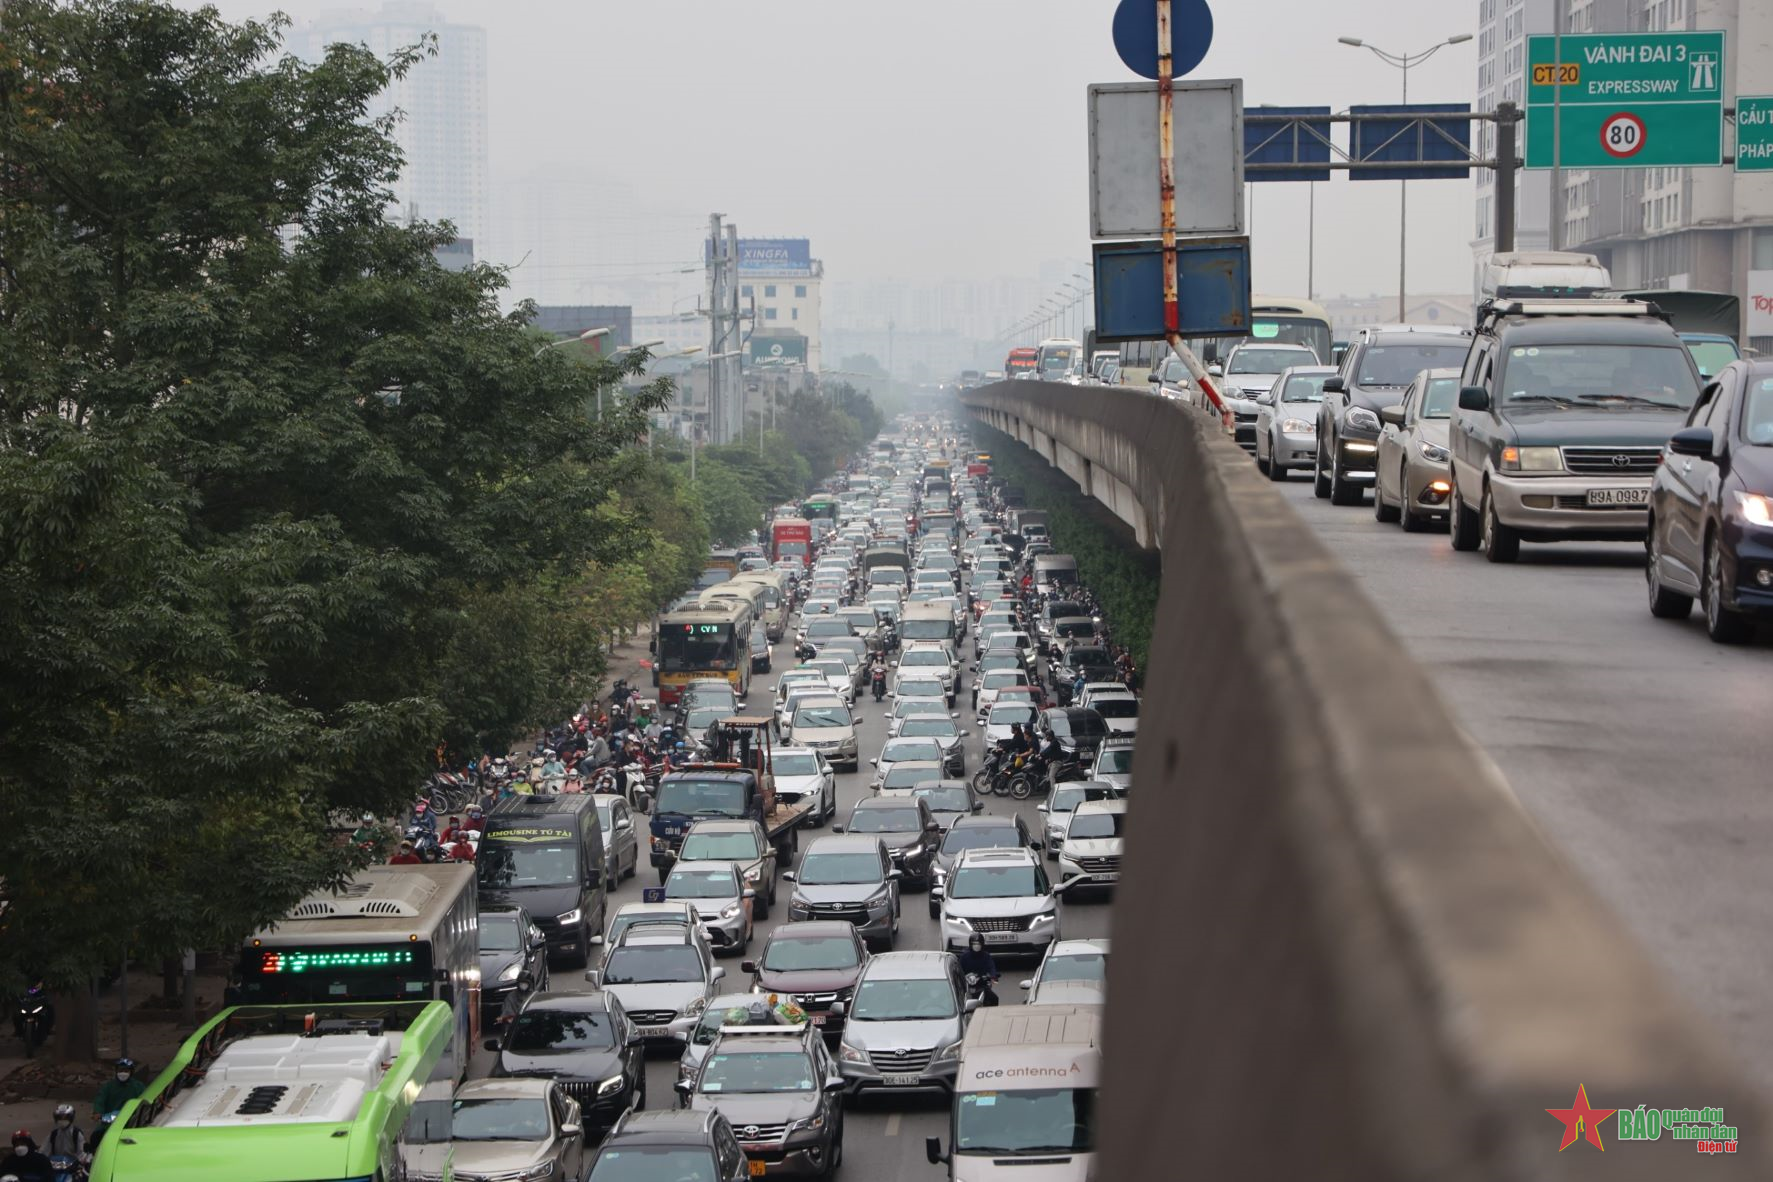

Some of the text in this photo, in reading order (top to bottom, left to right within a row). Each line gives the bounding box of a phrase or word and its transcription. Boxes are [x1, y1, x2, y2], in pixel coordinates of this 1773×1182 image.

[1584, 43, 1687, 64] VÀNH ĐAI 3
[1588, 79, 1680, 95] EXPRESSWAY
[1610, 125, 1636, 145] 80
[1739, 139, 1773, 158] PHÁP
[744, 249, 789, 259] XINGFA
[487, 829, 538, 837] LIMOUSINE
[976, 1069, 1004, 1079] ace
[1006, 1067, 1067, 1077] antenna
